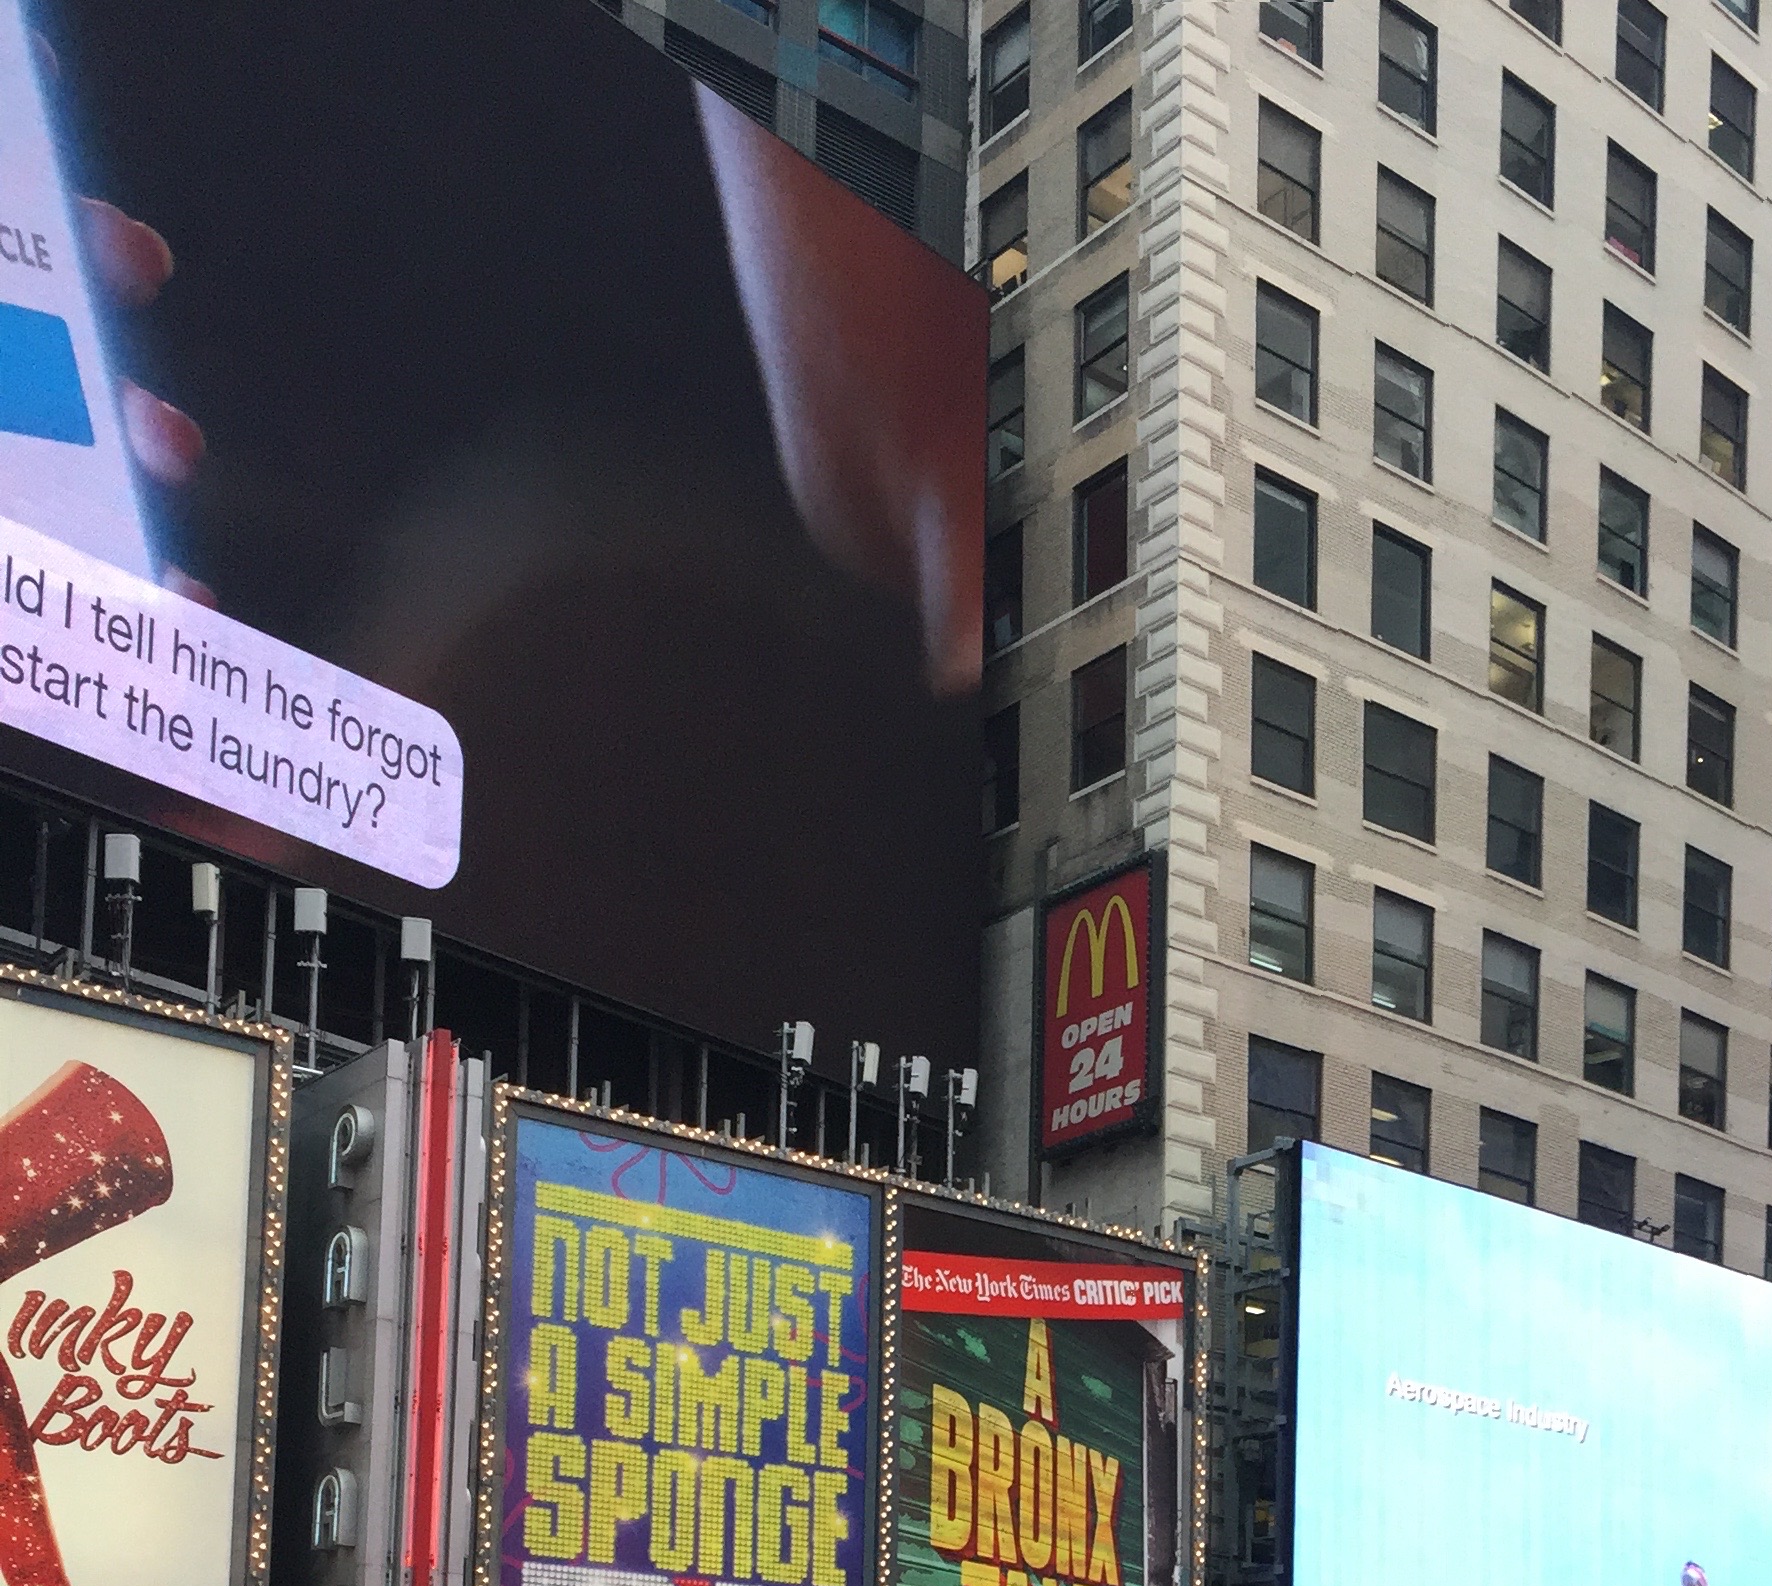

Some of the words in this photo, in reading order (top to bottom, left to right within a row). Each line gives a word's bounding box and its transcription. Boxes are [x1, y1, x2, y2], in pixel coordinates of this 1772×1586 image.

[4, 556, 43, 616] ld
[64, 580, 73, 629] I
[91, 598, 156, 664] tell
[172, 630, 248, 704] him
[266, 668, 313, 731] he
[328, 698, 442, 788] forgot
[1061, 1002, 1133, 1048] OPEN
[1069, 1037, 1123, 1094] 24
[1051, 1079, 1140, 1132] HOURS
[902, 1265, 932, 1292] The
[936, 1269, 974, 1293] New
[975, 1273, 1017, 1302] York
[1019, 1275, 1070, 1301] Times
[1143, 1281, 1183, 1305] PICK
[32, 1374, 225, 1464] Boots
[1385, 1373, 1499, 1420] Aerospace
[1507, 1398, 1588, 1442] Industry
